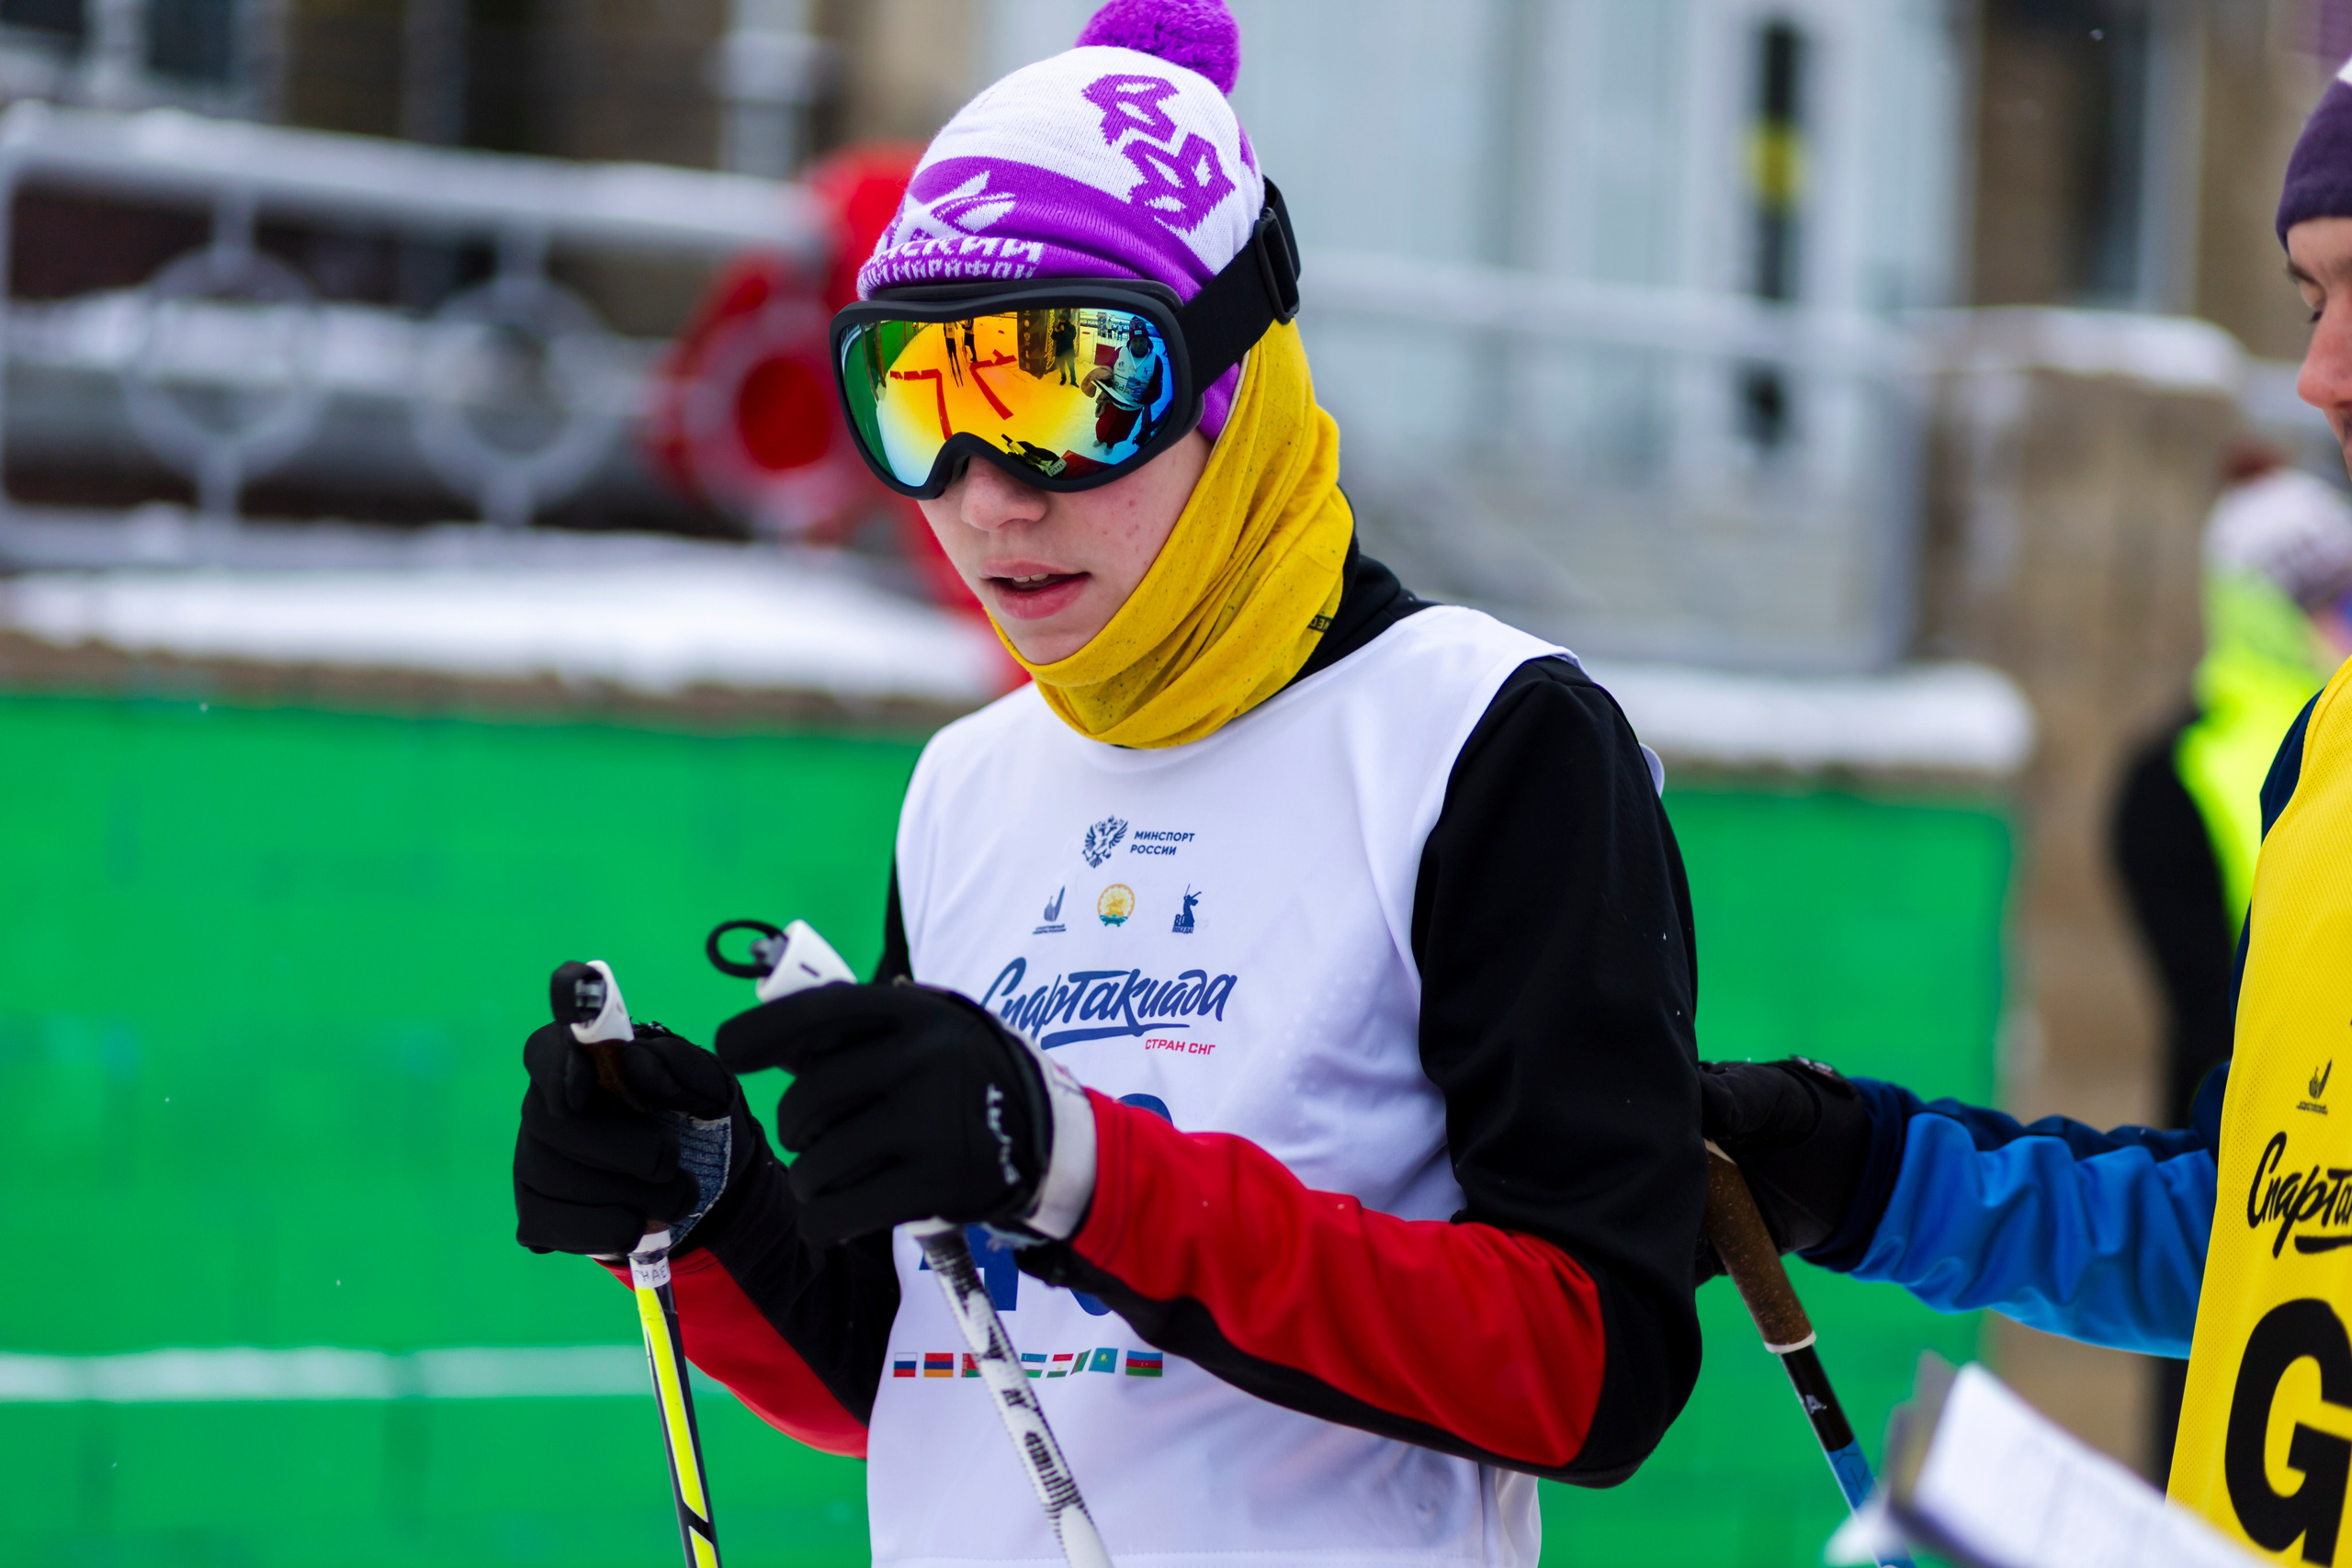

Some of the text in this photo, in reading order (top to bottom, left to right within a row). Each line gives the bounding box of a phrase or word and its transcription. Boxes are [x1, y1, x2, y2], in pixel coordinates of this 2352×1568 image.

[1134, 830, 1195, 843] МИНСПОРТ
[1129, 844, 1177, 856] РОССИИ
[980, 956, 1238, 1043] Спартакиада
[1145, 1038, 1216, 1055] СТРАН СНГ
[2224, 1298, 2352, 1568] G
